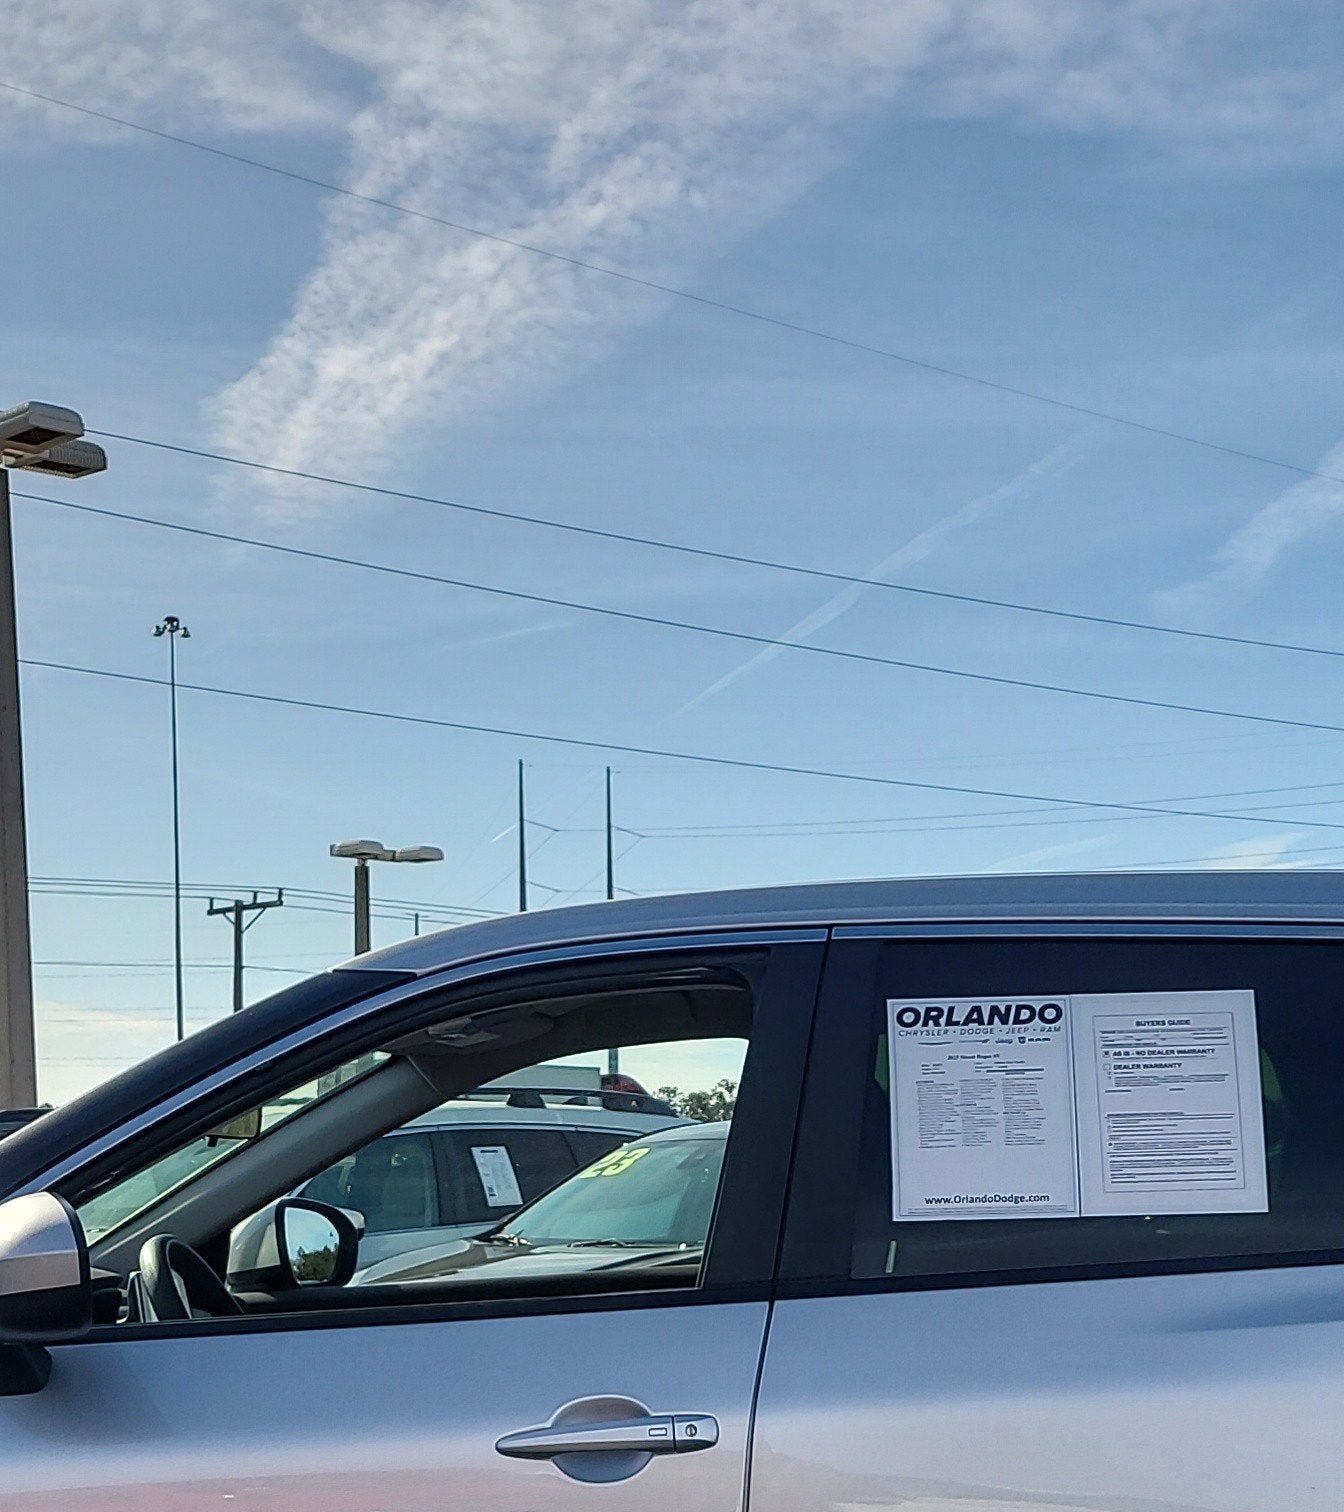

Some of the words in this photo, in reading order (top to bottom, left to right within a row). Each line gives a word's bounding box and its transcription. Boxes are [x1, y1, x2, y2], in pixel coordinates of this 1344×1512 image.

[896, 1003, 1063, 1028] ORLANDO
[898, 1029, 949, 1037] CHRYSLER
[959, 1028, 995, 1036] DODGE
[1005, 1026, 1030, 1035] JEEP
[924, 1194, 1050, 1205] www.OrlandoDodge.com
